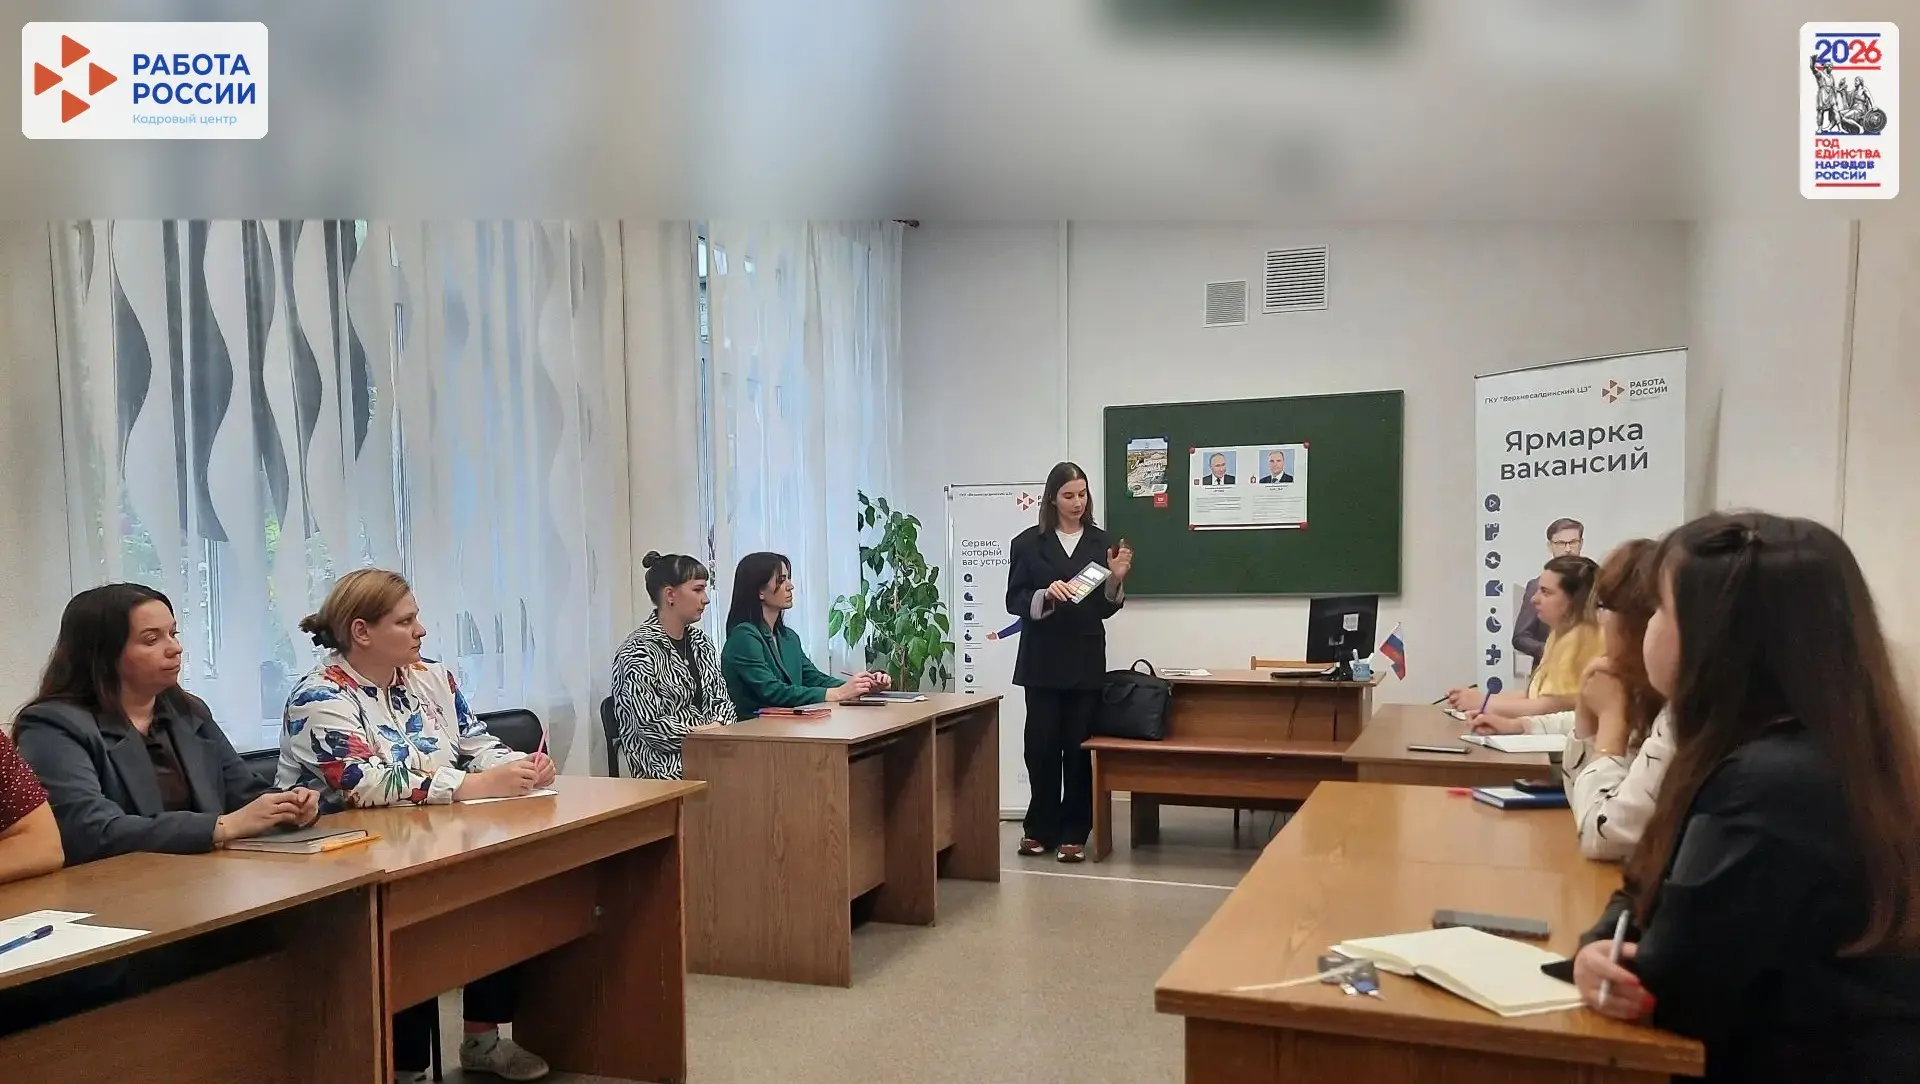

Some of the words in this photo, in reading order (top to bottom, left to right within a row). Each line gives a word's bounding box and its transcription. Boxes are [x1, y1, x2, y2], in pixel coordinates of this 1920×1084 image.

[1630, 378, 1666, 389] РАБОТА
[1630, 386, 1668, 397] РОССИИ
[1484, 396, 1498, 404] ГКУ
[1505, 422, 1644, 455] Ярмарка
[1500, 446, 1649, 481] вакансий
[962, 539, 1000, 548] Сервис,
[961, 548, 1002, 557] который
